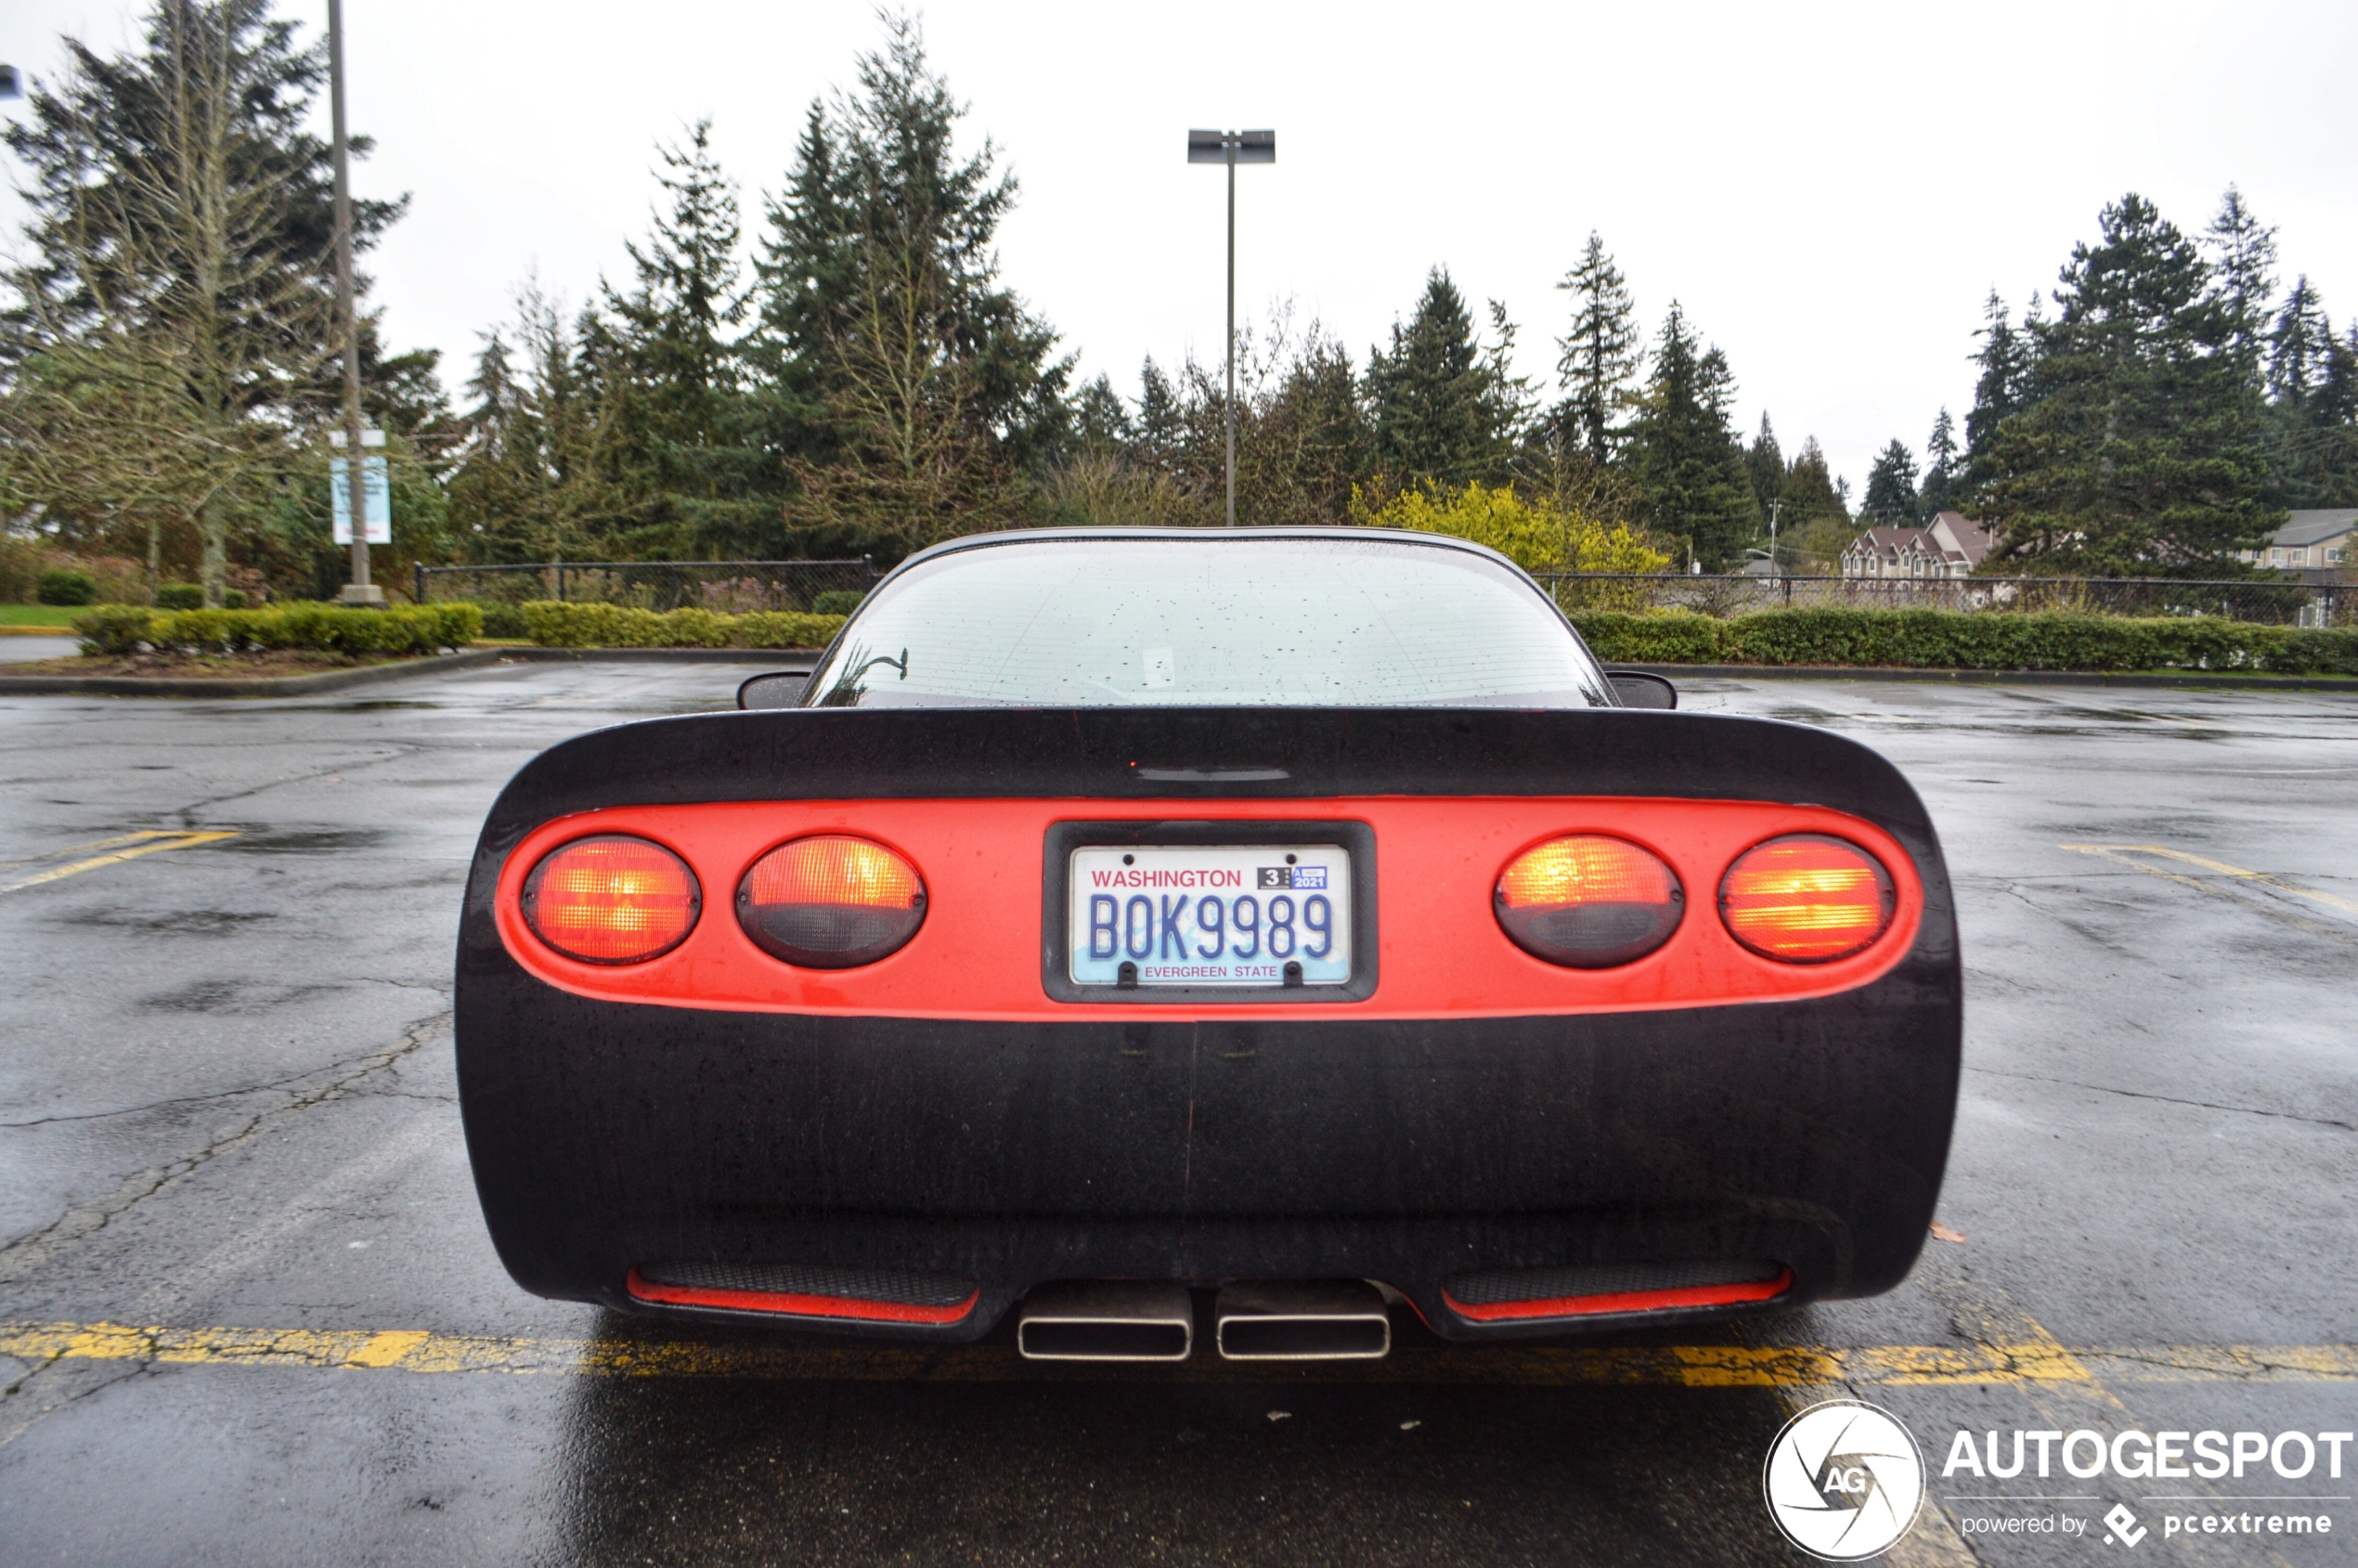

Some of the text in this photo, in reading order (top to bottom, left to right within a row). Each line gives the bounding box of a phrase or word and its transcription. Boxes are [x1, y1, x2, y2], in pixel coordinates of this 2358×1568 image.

[1091, 870, 1241, 888] WASHINGTON
[1265, 869, 1279, 886] 3
[1294, 877, 1324, 888] 2021
[1090, 894, 1332, 960] BOK9989
[1145, 966, 1277, 978] EVERGREEN STATE
